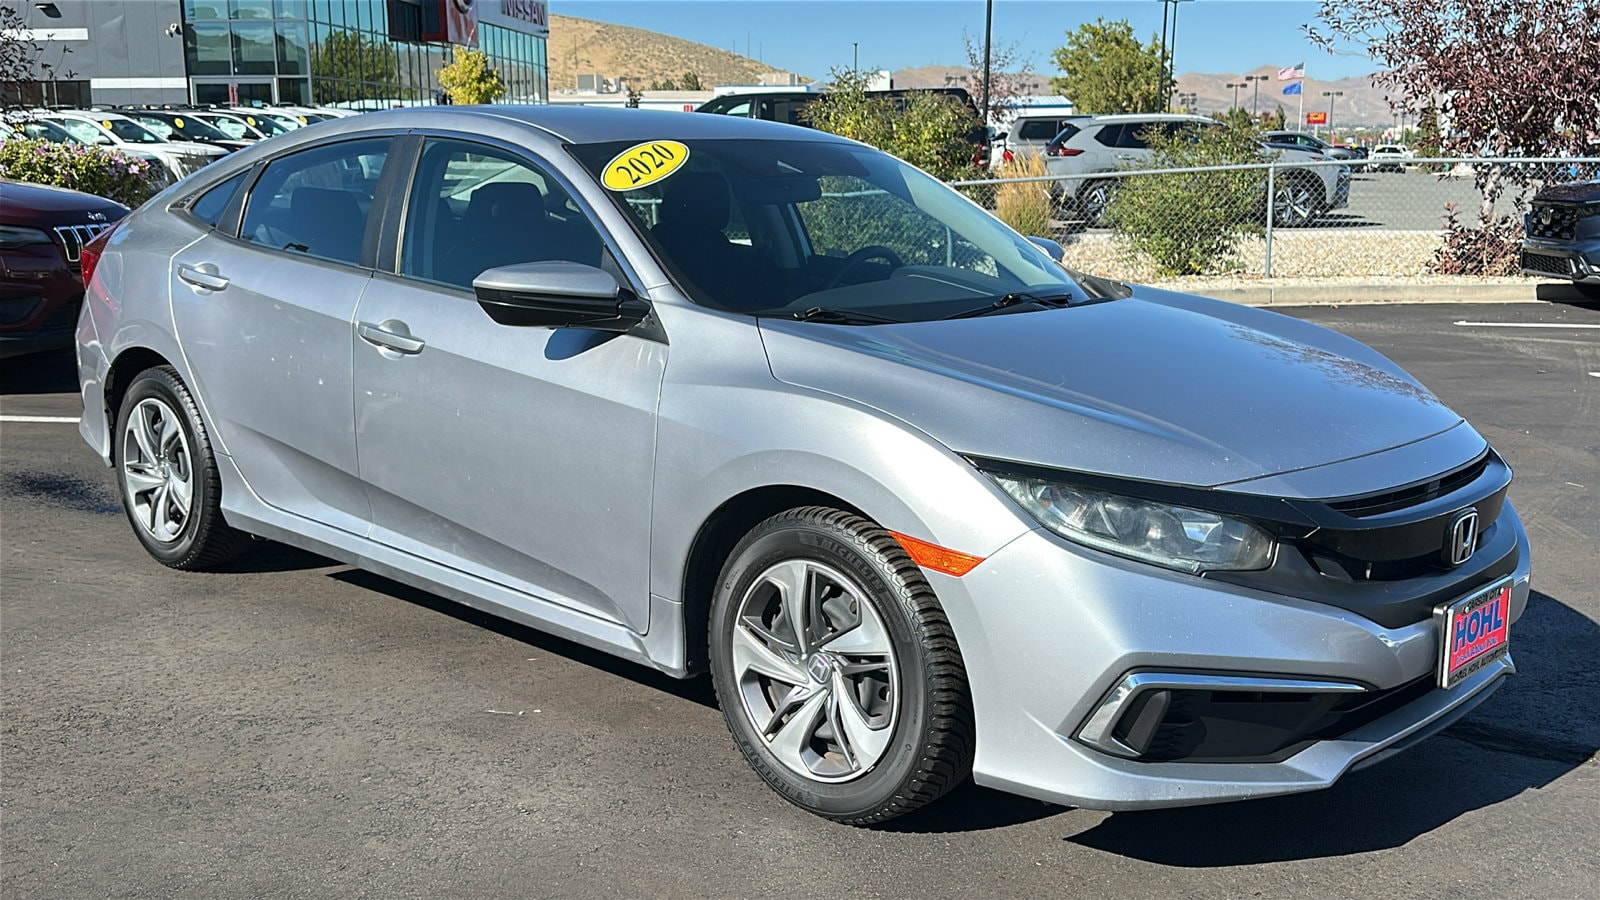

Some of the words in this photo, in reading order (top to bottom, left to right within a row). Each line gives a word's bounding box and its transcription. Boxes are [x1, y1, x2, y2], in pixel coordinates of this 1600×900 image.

[502, 0, 546, 26] NISSAN
[616, 143, 675, 184] 2020
[822, 538, 886, 594] MICHELIN
[1454, 599, 1504, 654] HOHL
